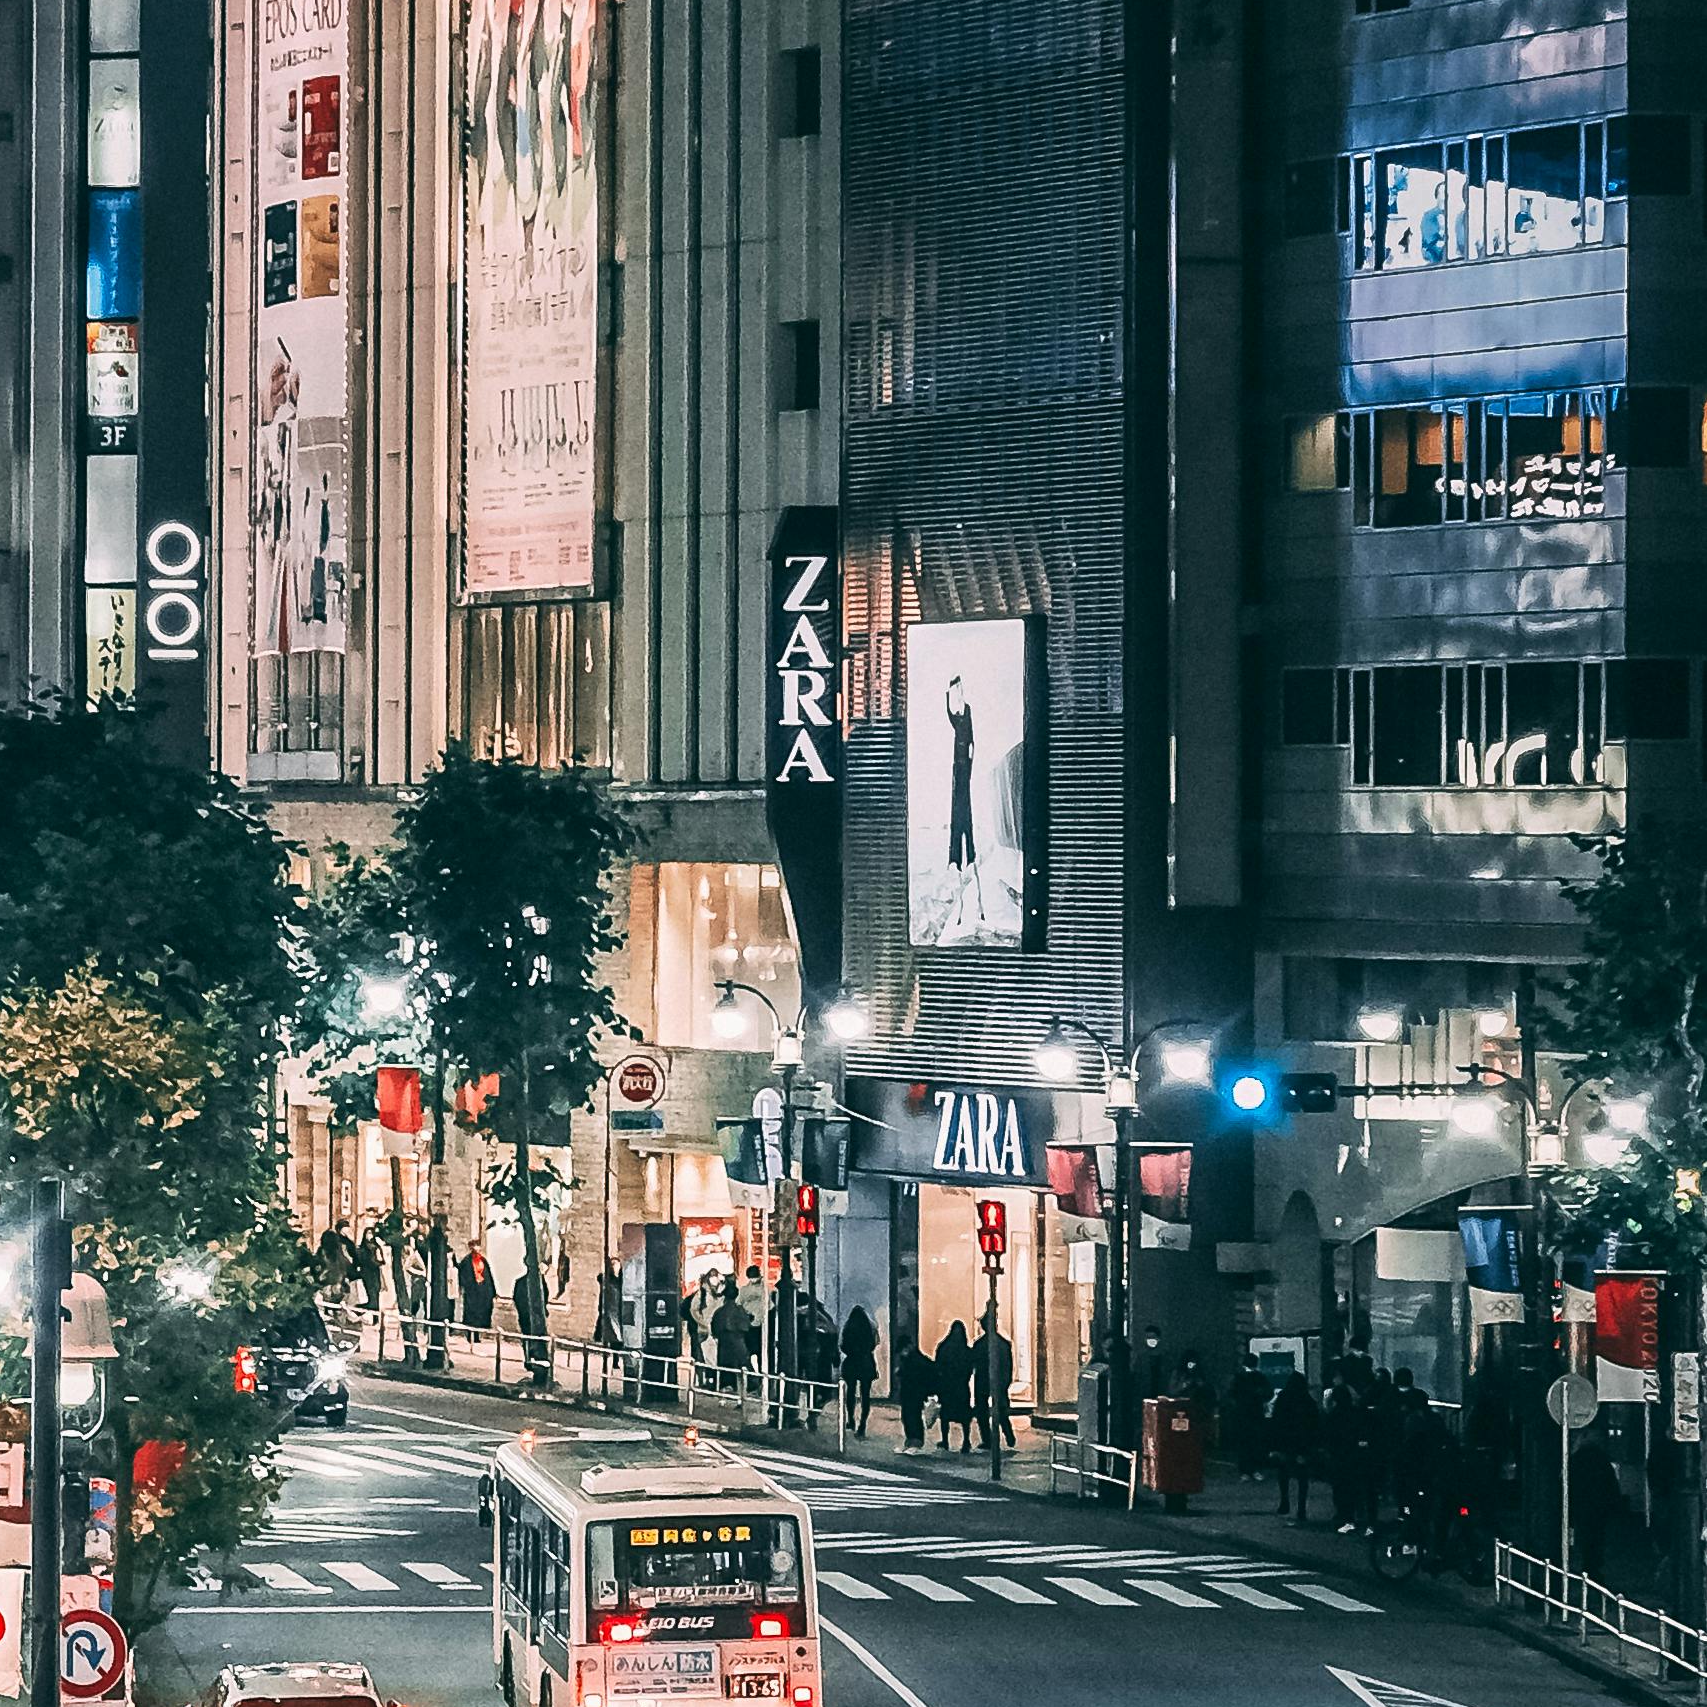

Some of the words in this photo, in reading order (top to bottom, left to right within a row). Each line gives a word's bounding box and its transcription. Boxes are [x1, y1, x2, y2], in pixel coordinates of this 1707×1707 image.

[100, 425, 127, 447] 3F
[779, 556, 834, 784] ZARA
[932, 1089, 1030, 1178] ZARA
[678, 1615, 715, 1629] BUS
